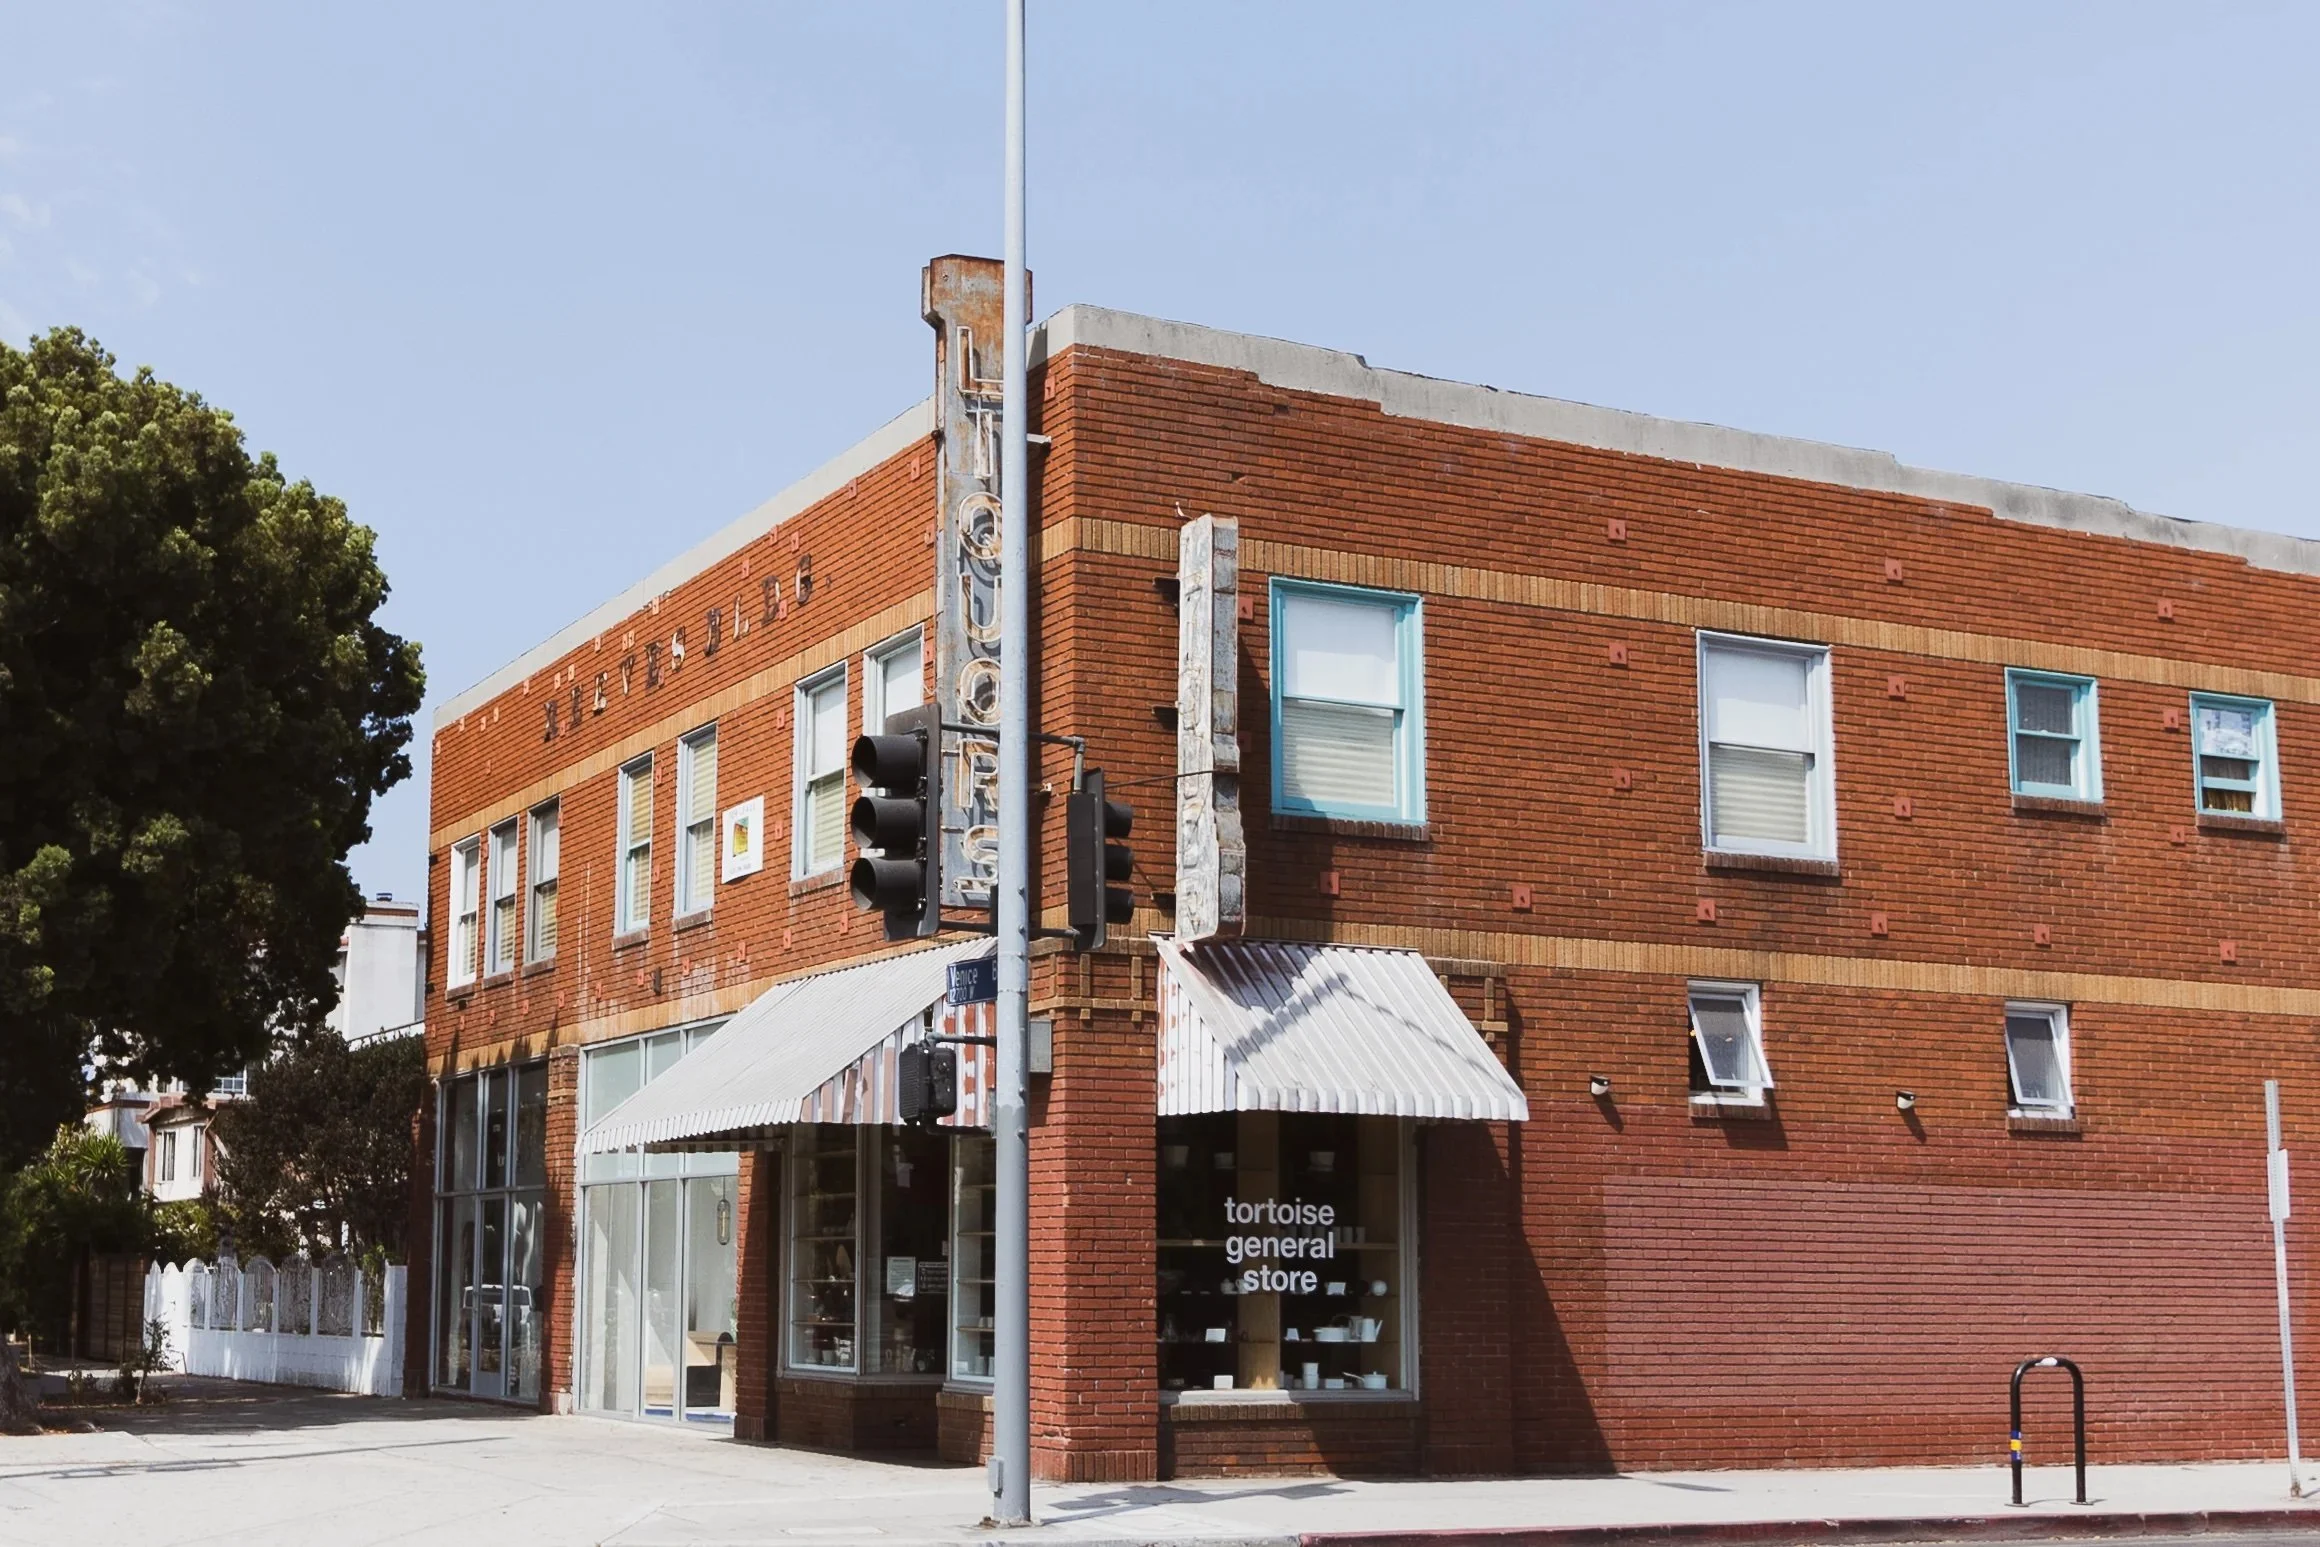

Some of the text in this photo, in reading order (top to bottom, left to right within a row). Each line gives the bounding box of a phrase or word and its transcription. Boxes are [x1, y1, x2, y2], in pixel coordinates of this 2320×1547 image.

[955, 325, 1003, 895] LIQUORS
[949, 966, 978, 988] Venice
[1223, 1196, 1335, 1225] tortoise
[1225, 1231, 1335, 1264] general
[1243, 1264, 1318, 1293] store
